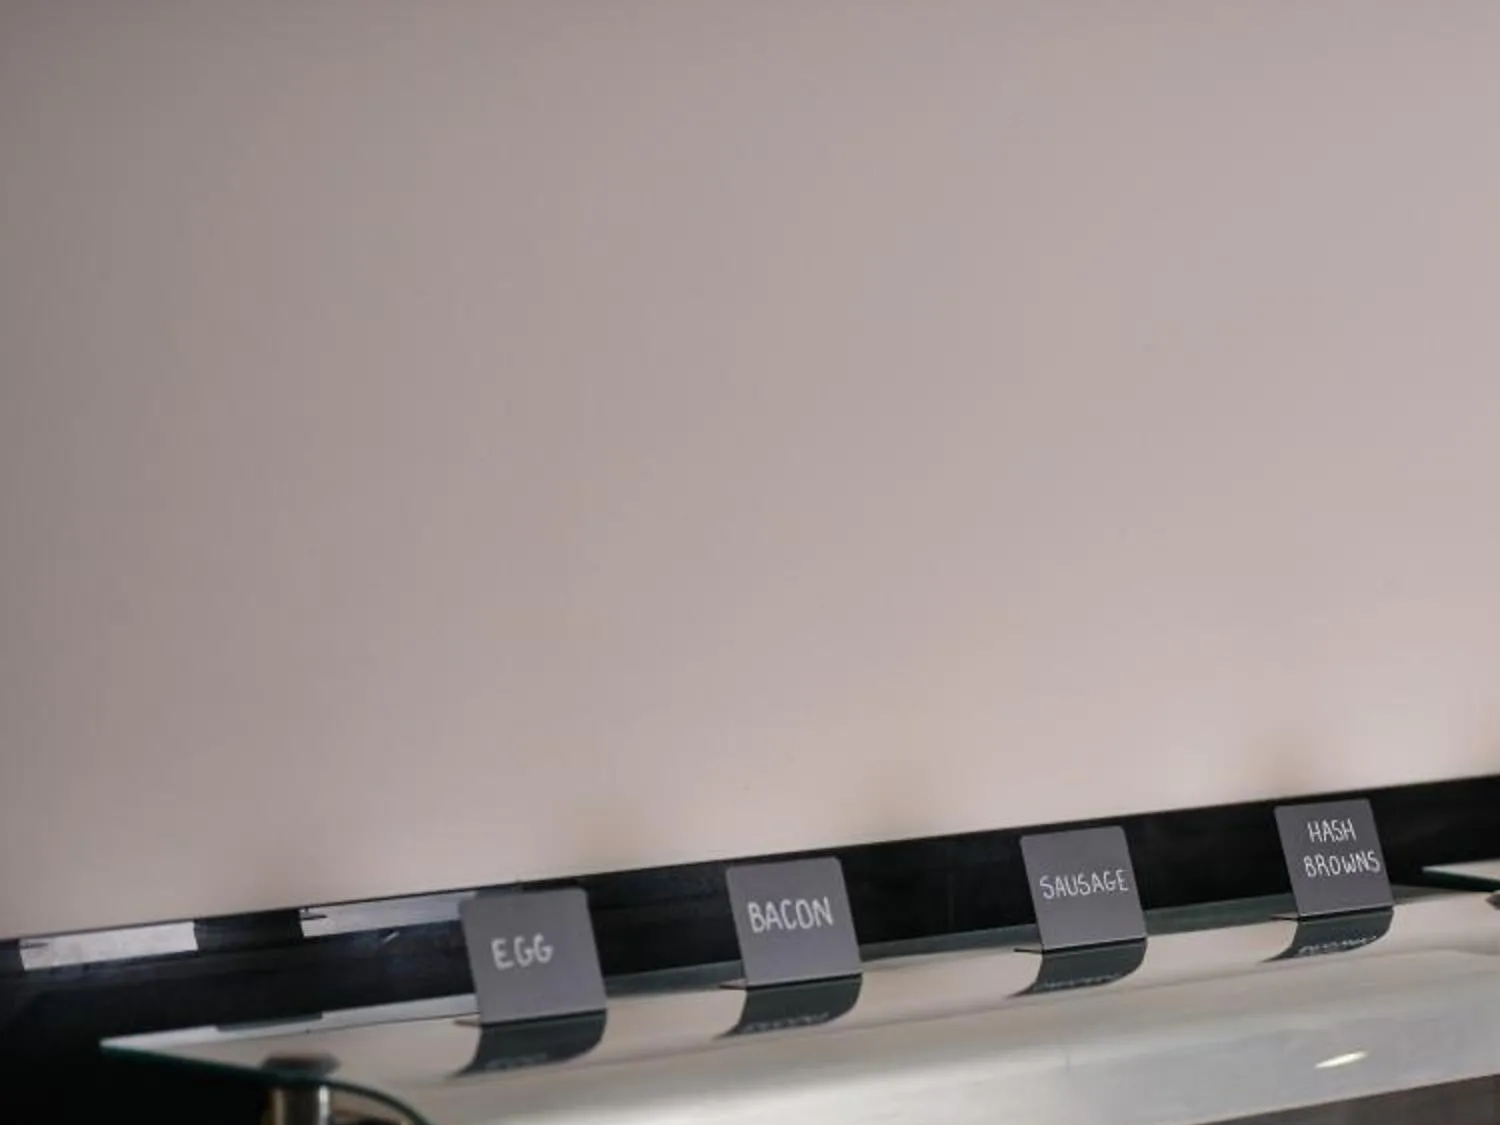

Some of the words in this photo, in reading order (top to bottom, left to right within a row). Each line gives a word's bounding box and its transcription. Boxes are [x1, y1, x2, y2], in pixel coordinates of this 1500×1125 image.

[1307, 817, 1357, 844] HASH
[1303, 850, 1381, 879] BROWNS
[1039, 868, 1129, 900] SAUSAGE
[747, 896, 834, 934] BACON
[490, 932, 554, 970] EGG
